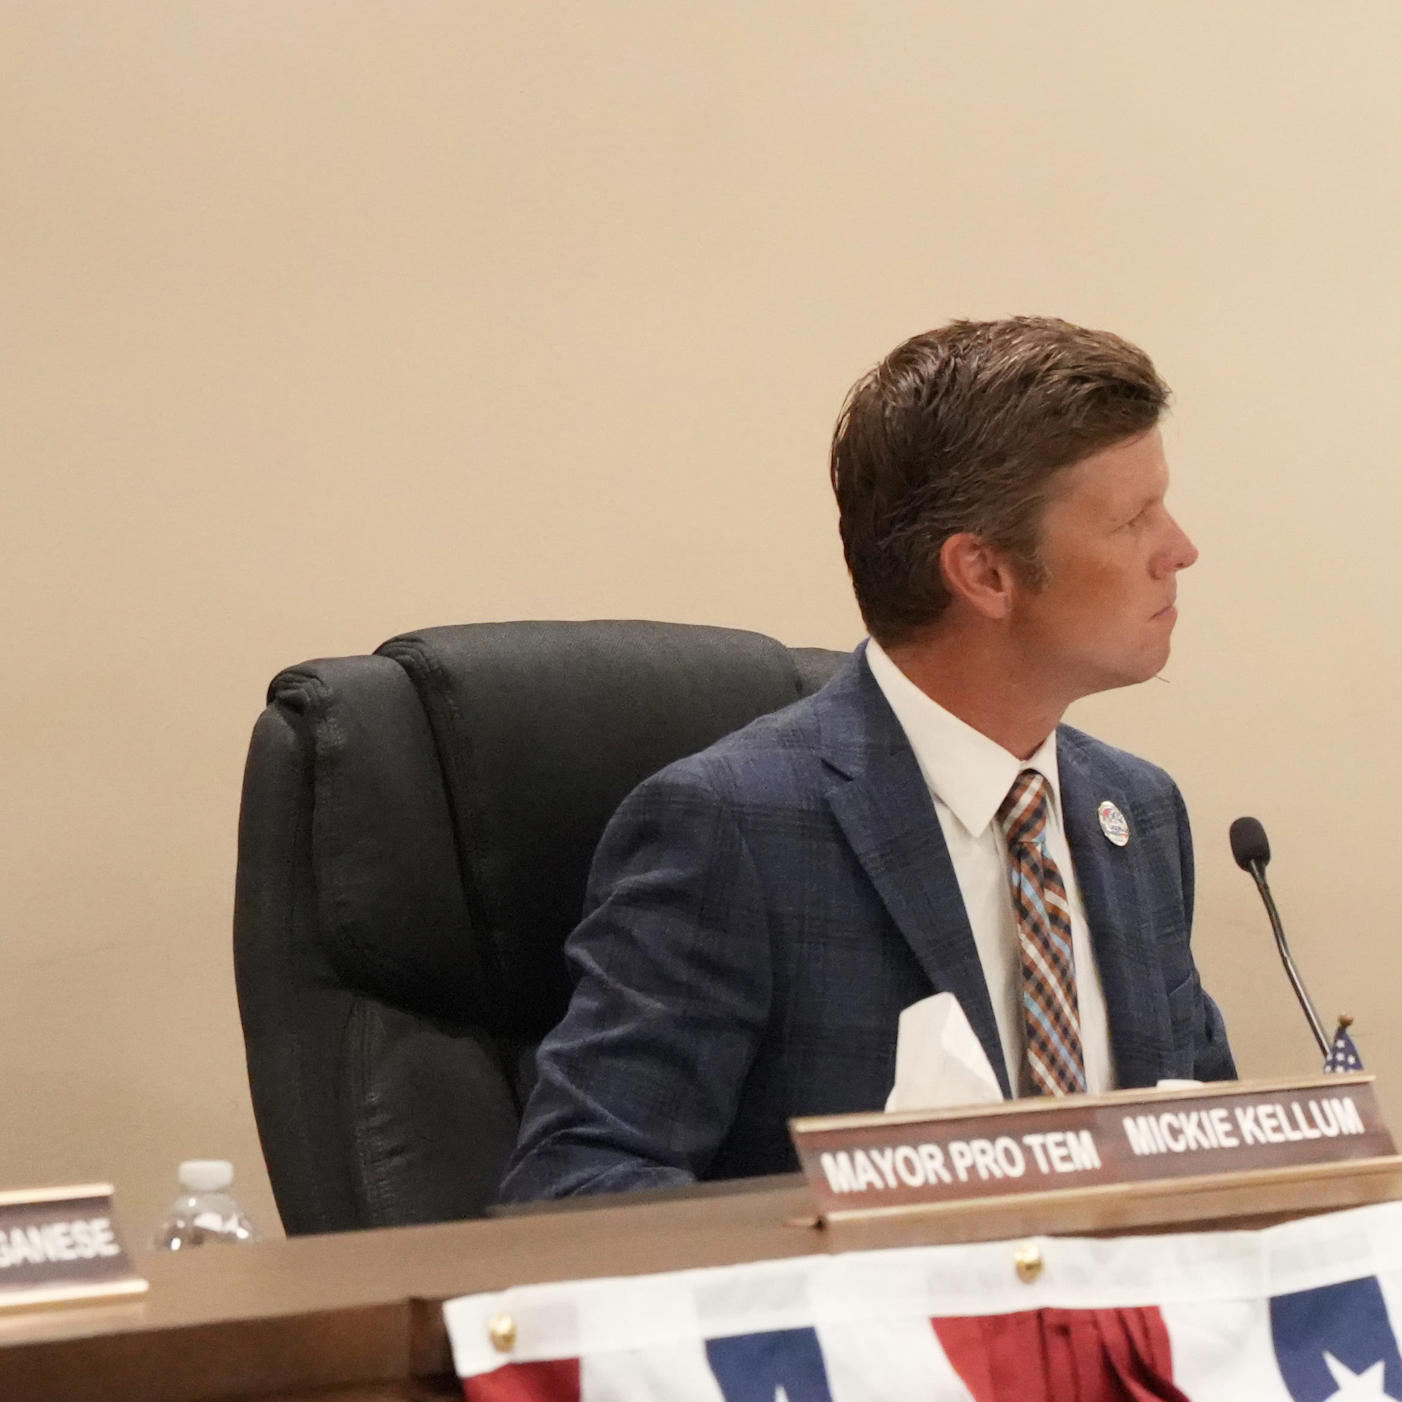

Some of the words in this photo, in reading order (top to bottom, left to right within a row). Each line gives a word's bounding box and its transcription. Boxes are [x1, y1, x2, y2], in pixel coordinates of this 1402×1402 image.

[820, 1145, 950, 1194] MAYOR
[948, 1135, 1026, 1183] PRO
[1022, 1129, 1101, 1175] TEM
[1122, 1105, 1240, 1156] MICKIE
[1237, 1096, 1365, 1144] KELLUM
